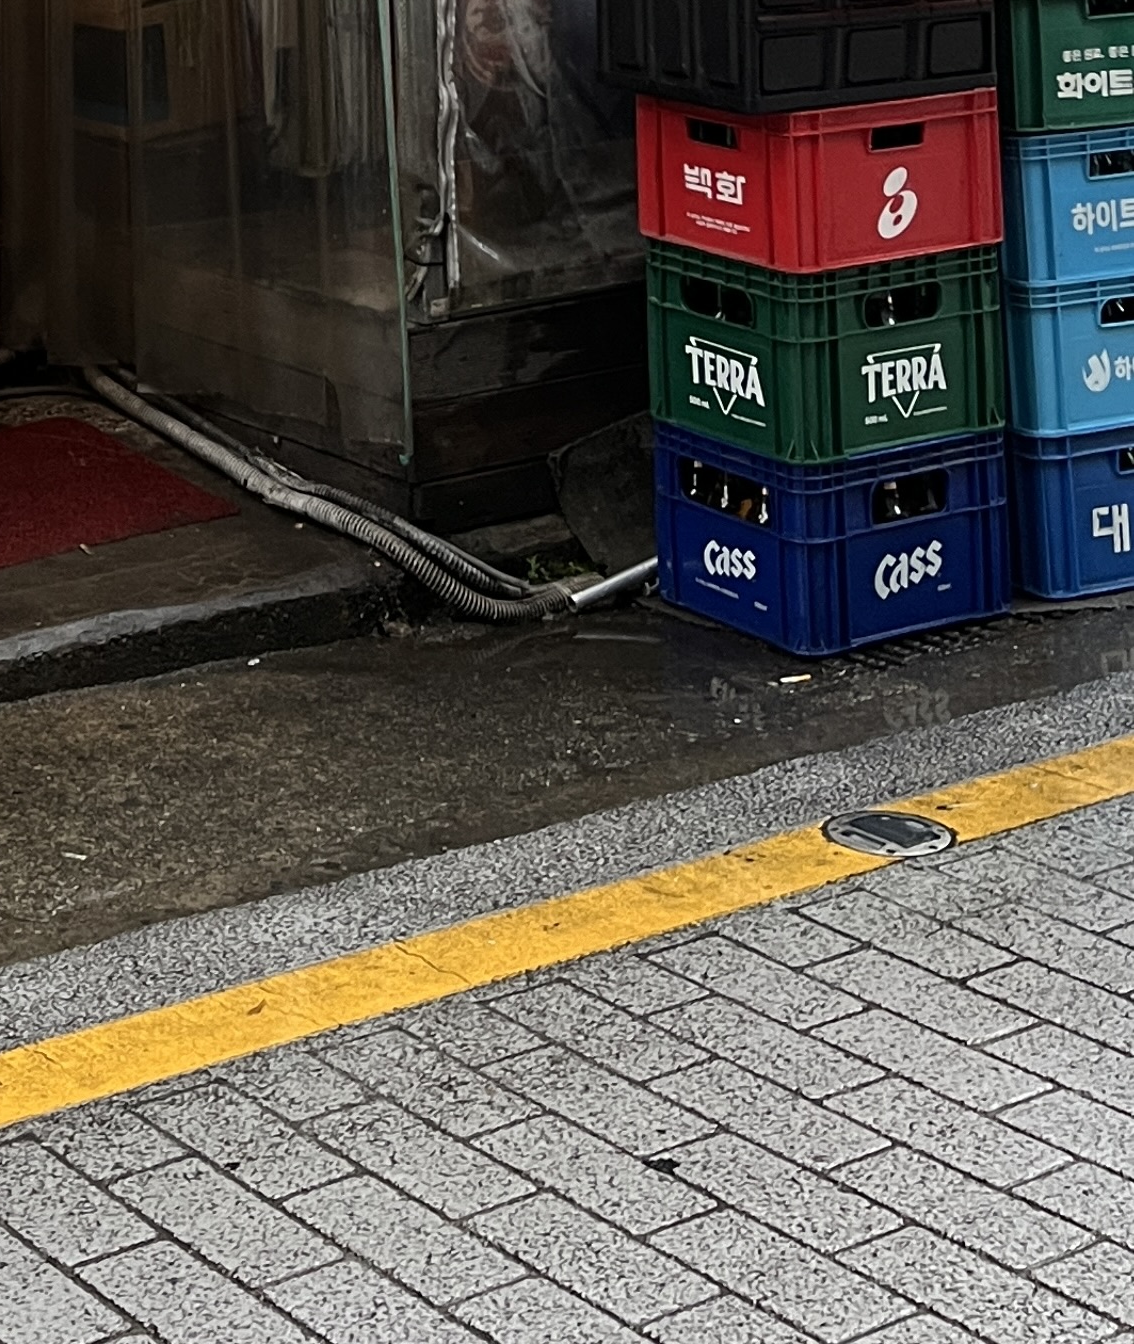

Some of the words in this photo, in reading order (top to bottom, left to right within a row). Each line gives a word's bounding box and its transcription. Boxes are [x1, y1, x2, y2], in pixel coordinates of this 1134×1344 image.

[1056, 69, 1134, 99] 화이트
[683, 163, 746, 205] 백화
[685, 344, 766, 408] TERRA
[861, 353, 948, 404] TERRA
[1092, 503, 1131, 553] 대
[703, 539, 757, 580] Cass
[874, 539, 943, 601] Cass
